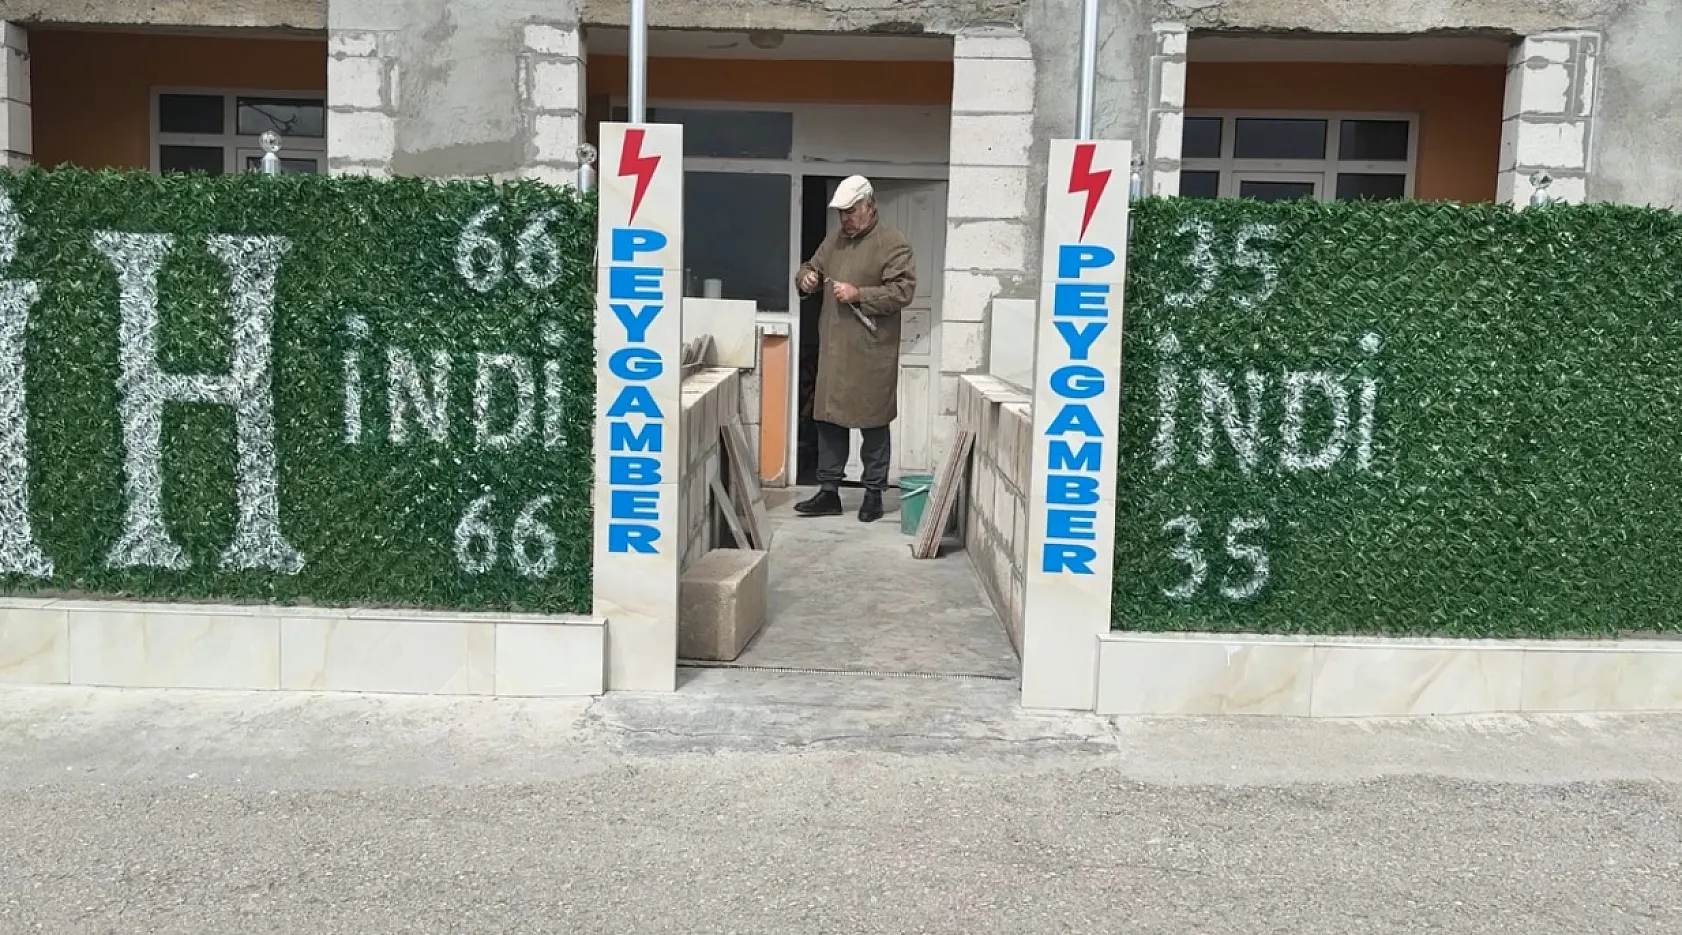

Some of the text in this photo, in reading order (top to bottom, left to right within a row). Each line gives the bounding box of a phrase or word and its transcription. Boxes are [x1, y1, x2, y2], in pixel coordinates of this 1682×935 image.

[456, 205, 562, 294] 66
[1162, 216, 1282, 310] 35
[607, 228, 667, 555] PEYGAMBER
[1043, 245, 1115, 575] PEYGAMBER
[453, 495, 557, 579] 66
[1159, 514, 1272, 601] 35
